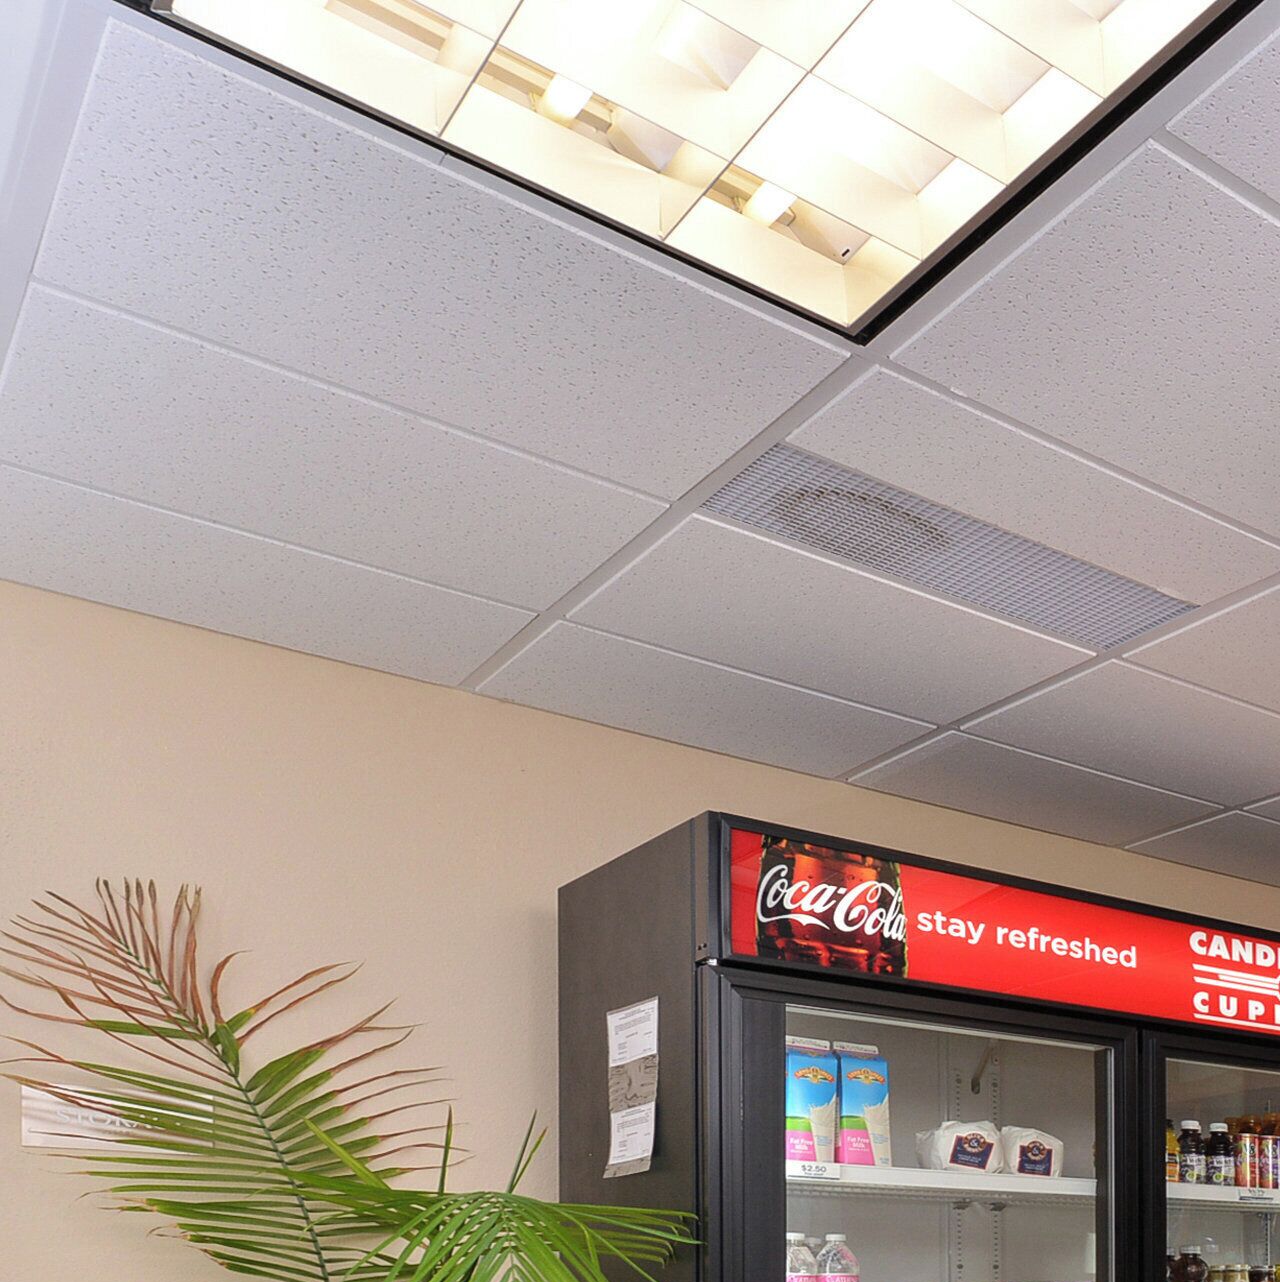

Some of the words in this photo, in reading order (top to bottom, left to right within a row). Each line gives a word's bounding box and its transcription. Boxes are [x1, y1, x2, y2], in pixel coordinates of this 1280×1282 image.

[755, 863, 908, 943] Coca-Cola
[916, 908, 986, 945] stay
[996, 924, 1138, 968] refreshed
[801, 1164, 828, 1174] $2.50
